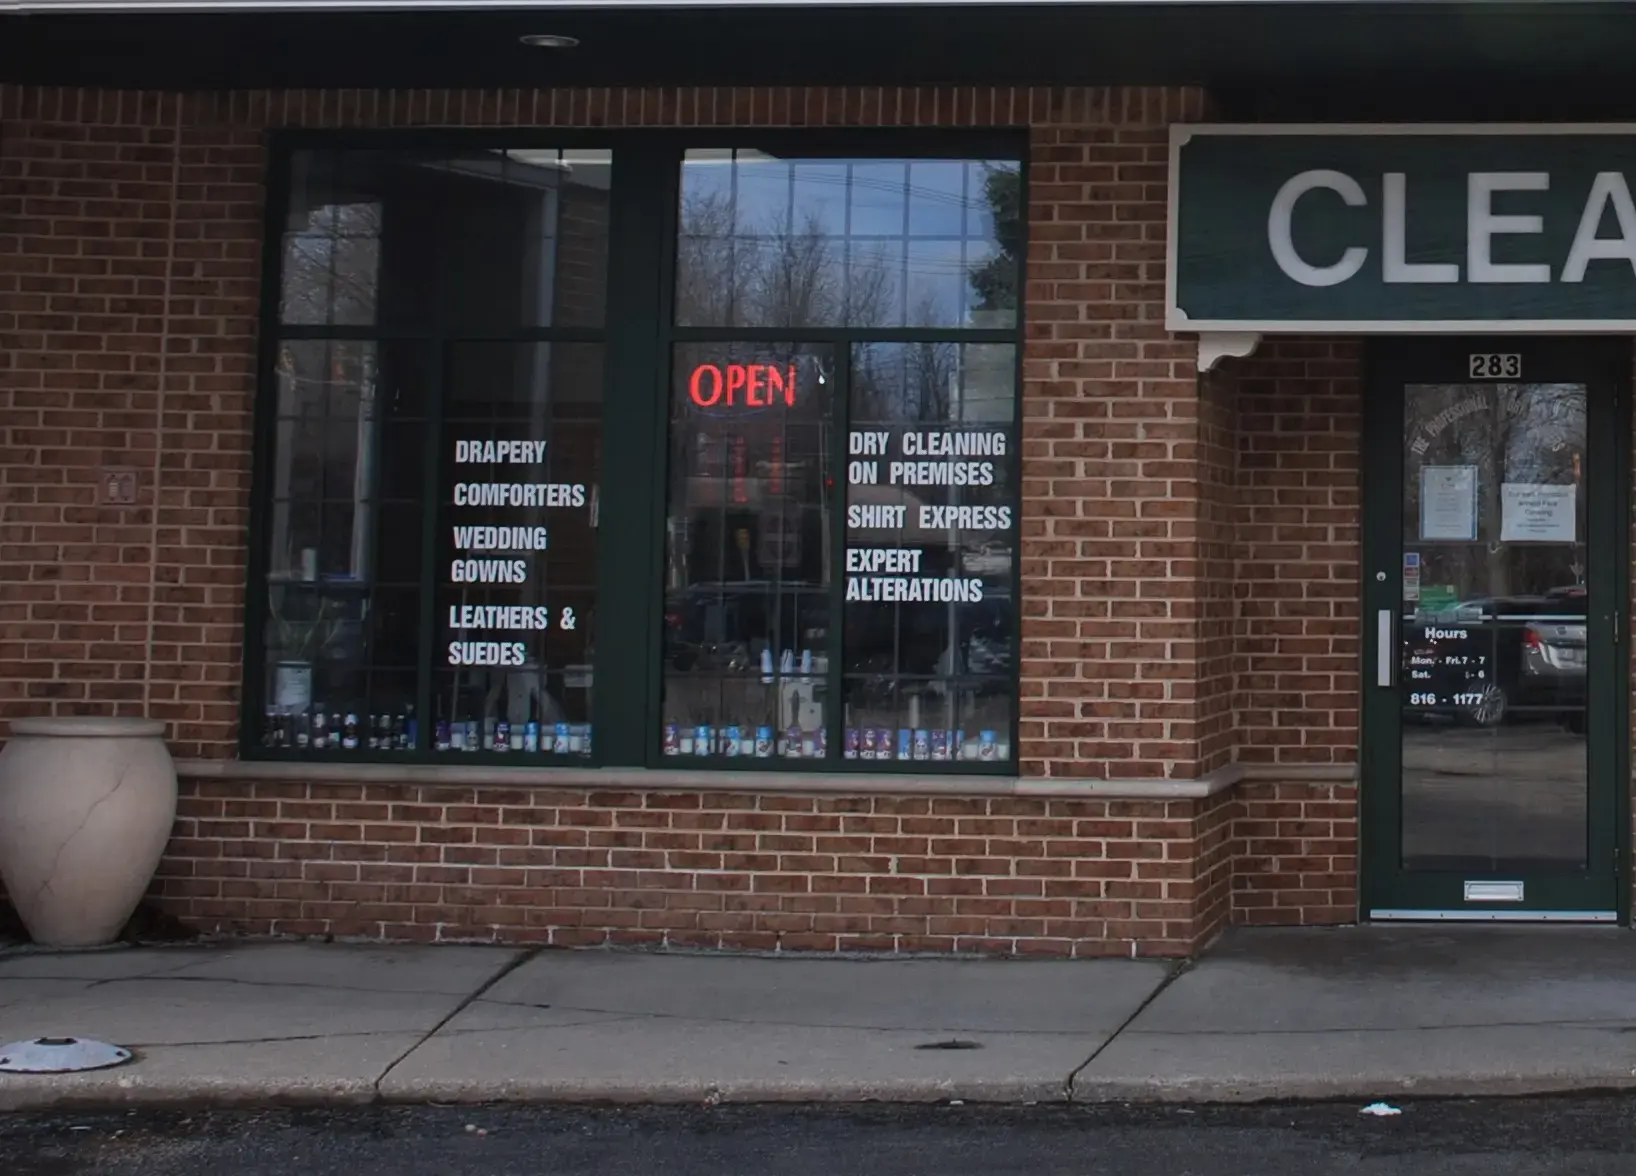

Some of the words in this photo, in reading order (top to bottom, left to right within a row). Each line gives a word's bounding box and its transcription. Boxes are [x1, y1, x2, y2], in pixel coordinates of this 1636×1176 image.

[1472, 355, 1519, 376] 283
[689, 364, 796, 407] OPEN
[456, 441, 546, 463] DRAPERY
[850, 432, 889, 455] DRY
[903, 432, 1005, 456] CLEANING
[849, 461, 877, 484] ON
[890, 462, 993, 485] PREMISES
[455, 483, 584, 507] COMFORTERS
[848, 505, 906, 528] SHIRT
[919, 505, 1011, 529] EXPRESS
[454, 527, 546, 549] WEDDING
[452, 560, 526, 583] GOWNS
[847, 549, 922, 572] EXPERT
[846, 578, 982, 602] ALTERATIONS
[450, 606, 547, 629] LEATHERS
[560, 607, 575, 629] &
[1425, 627, 1467, 639] Hours
[449, 642, 524, 665] SUEDES
[1411, 670, 1431, 679] Sat.
[1410, 692, 1437, 704] 816
[1452, 693, 1484, 704] 1177
